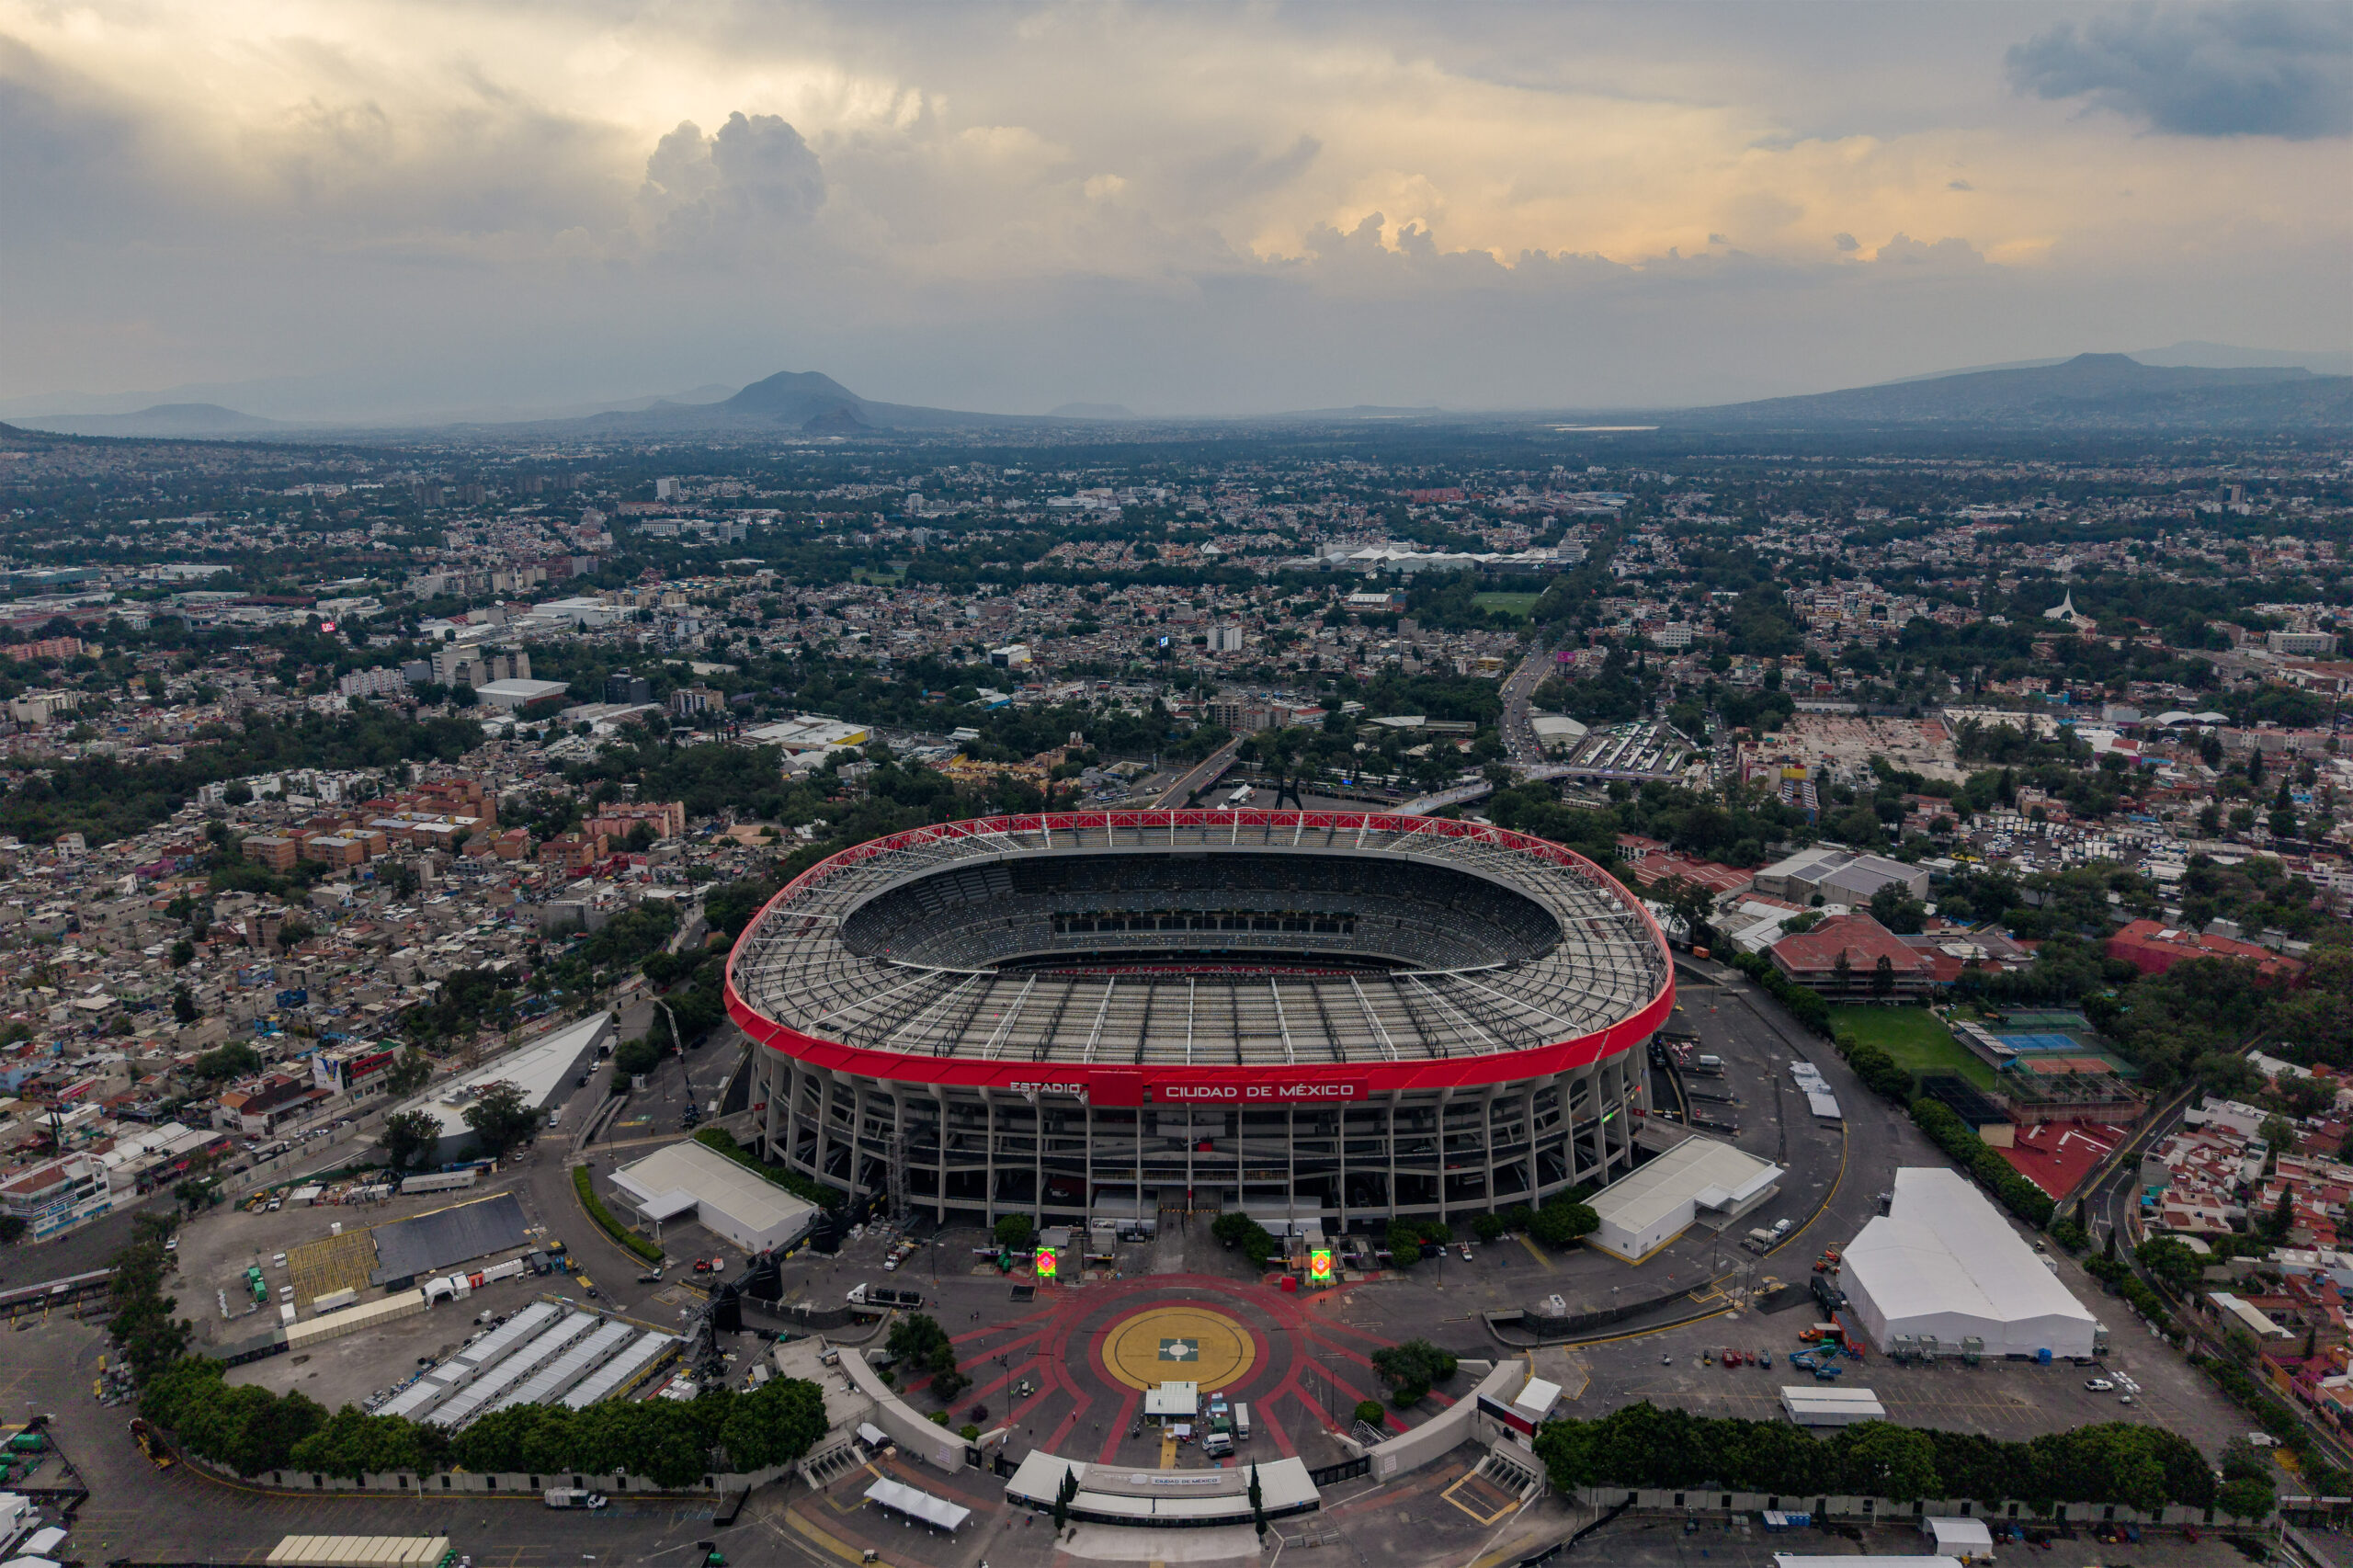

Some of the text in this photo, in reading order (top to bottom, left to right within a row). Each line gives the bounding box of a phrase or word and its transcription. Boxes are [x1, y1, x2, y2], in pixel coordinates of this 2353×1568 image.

[1010, 1082, 1080, 1094] ESTADIO
[1165, 1084, 1354, 1097] CIUDAD DE MÉXICO
